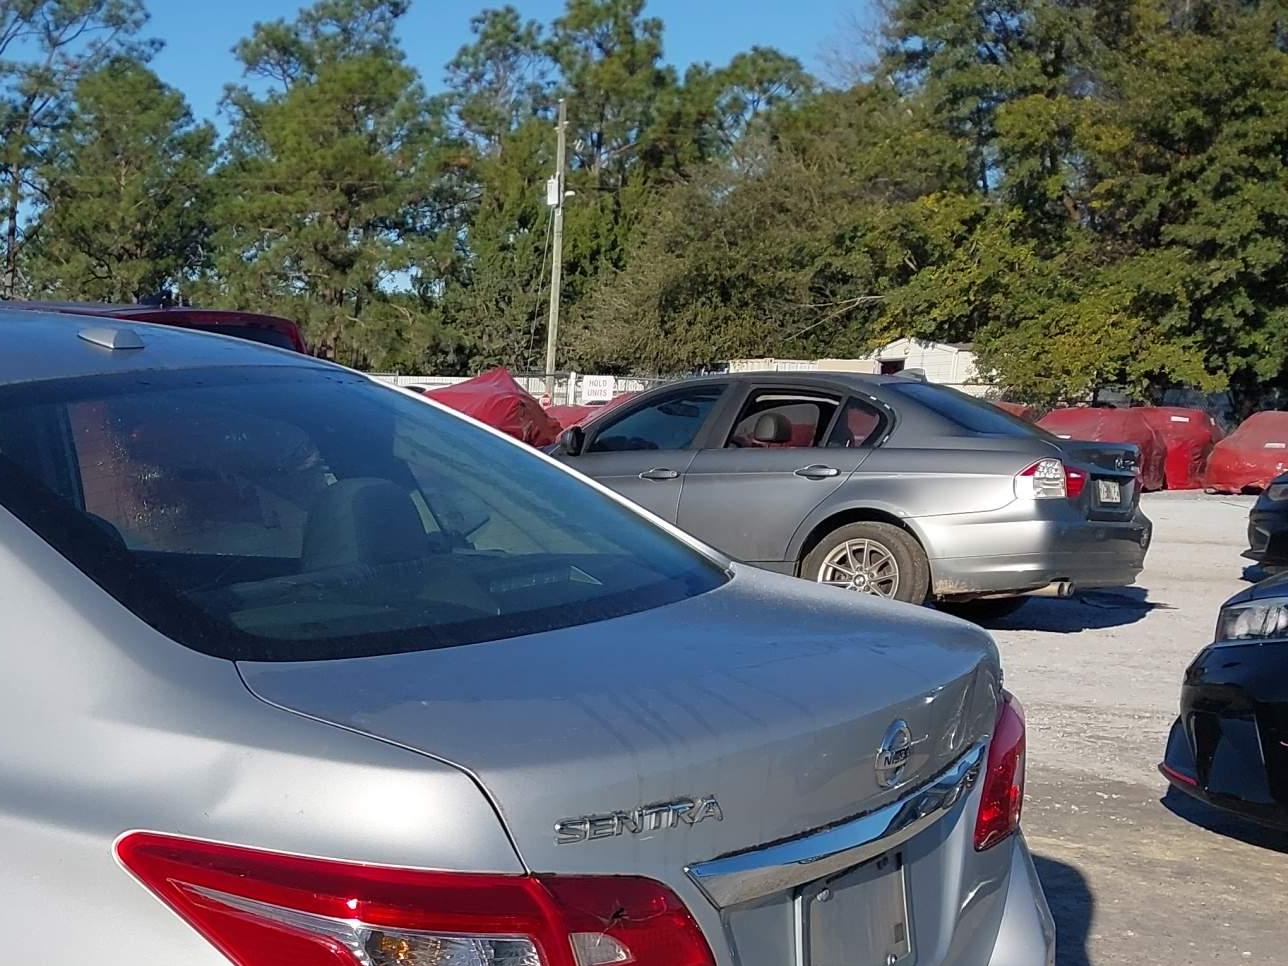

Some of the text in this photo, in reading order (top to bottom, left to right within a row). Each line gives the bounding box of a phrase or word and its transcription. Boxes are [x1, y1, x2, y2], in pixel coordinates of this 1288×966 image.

[588, 379, 608, 387] HOLD
[587, 388, 608, 397] UNITS
[553, 795, 723, 845] SENTRA
